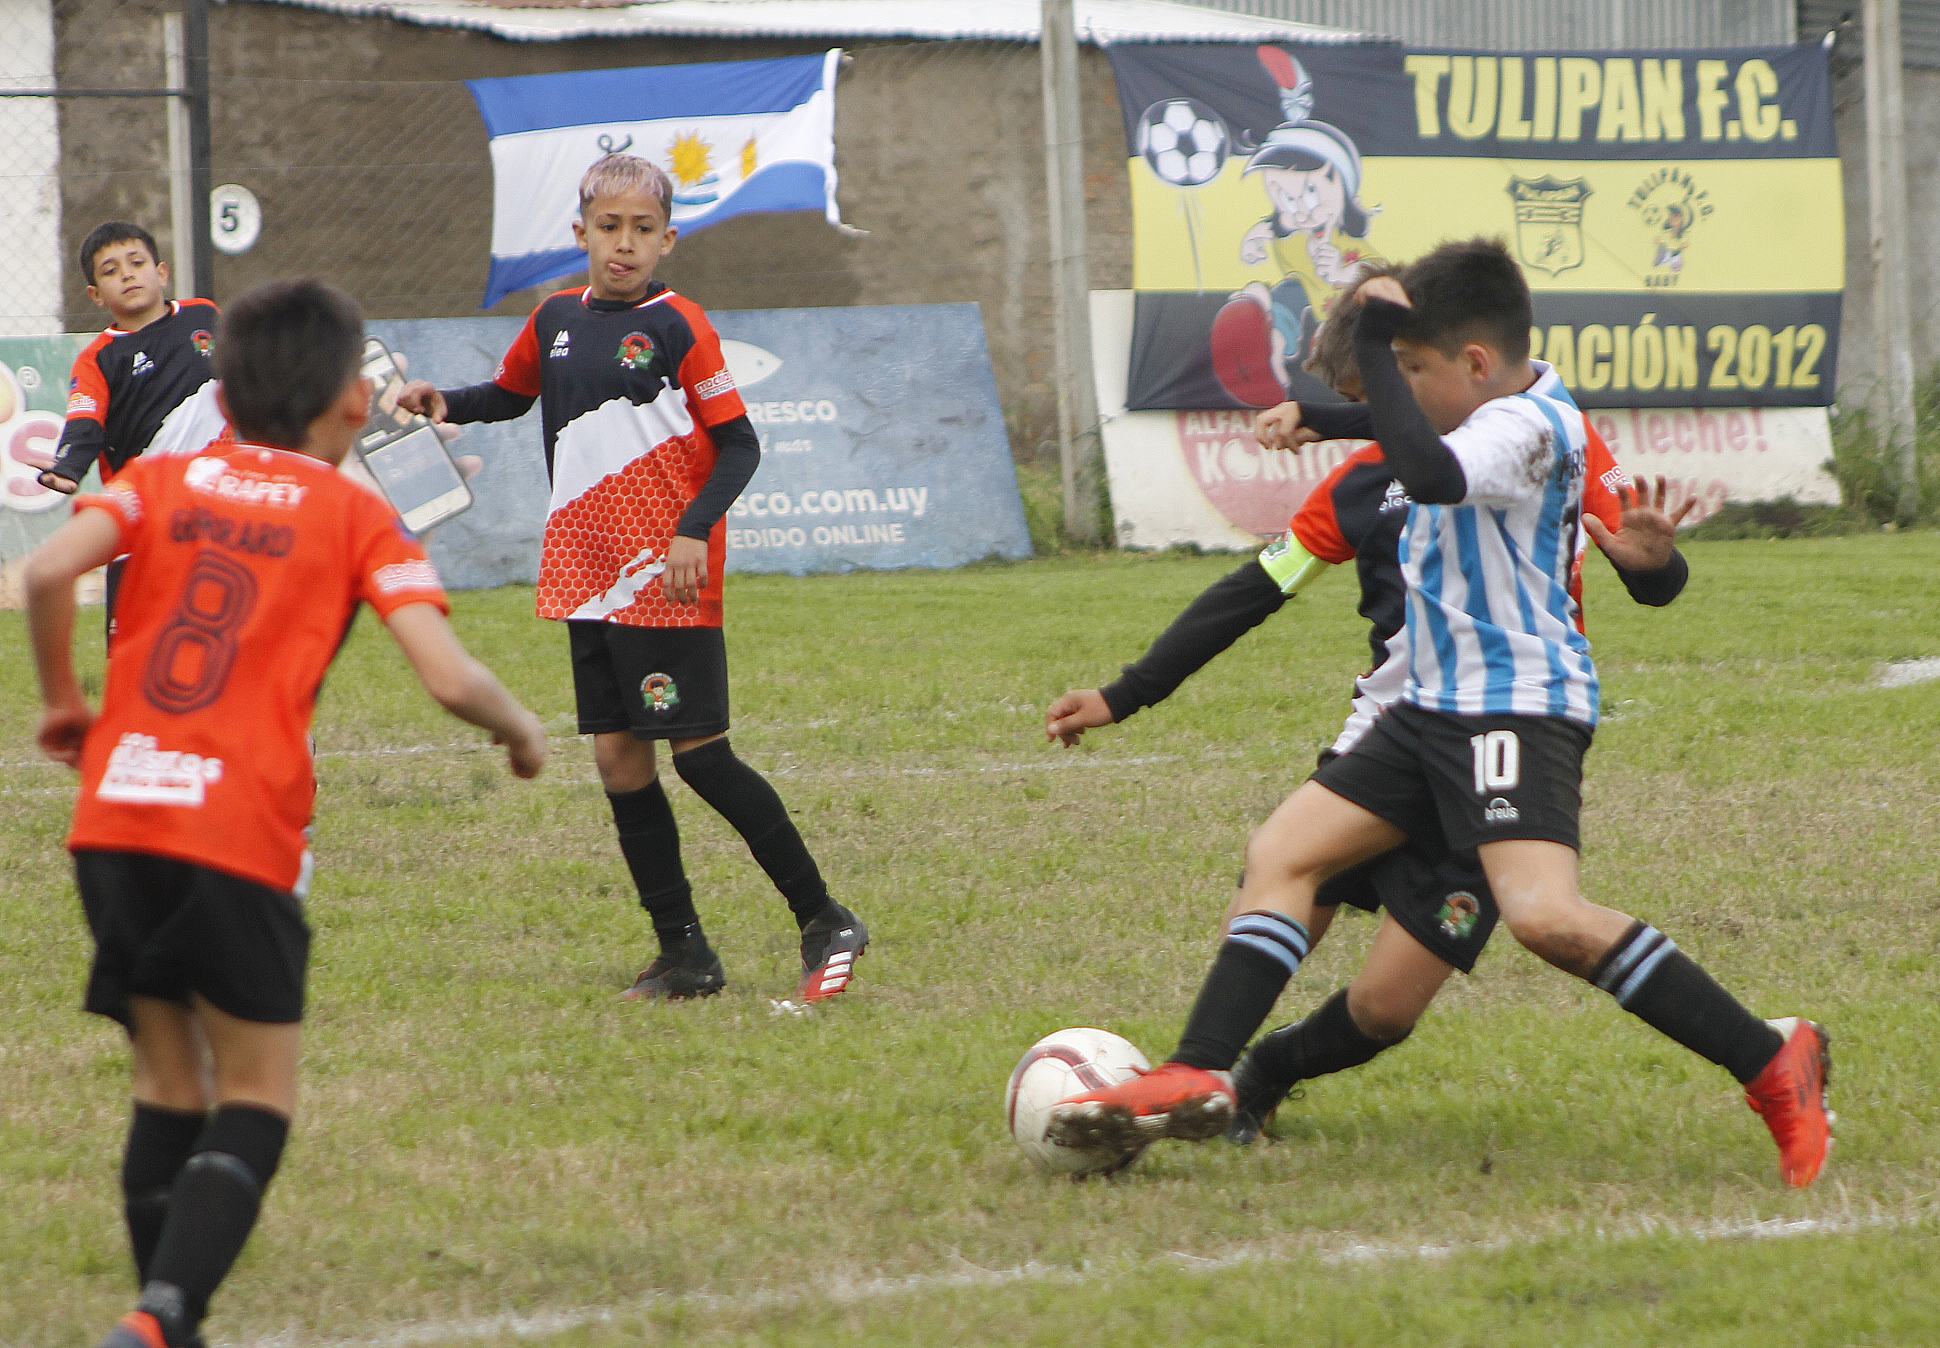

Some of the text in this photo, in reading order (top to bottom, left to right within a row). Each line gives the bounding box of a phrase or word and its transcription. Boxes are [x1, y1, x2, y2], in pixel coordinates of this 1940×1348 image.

[1404, 54, 1799, 141] TULIPAN F.C.
[220, 200, 240, 233] 5
[1706, 323, 1826, 390] 2012
[813, 523, 907, 546] ONLINE
[140, 546, 260, 716] 8
[1470, 730, 1520, 794] 10
